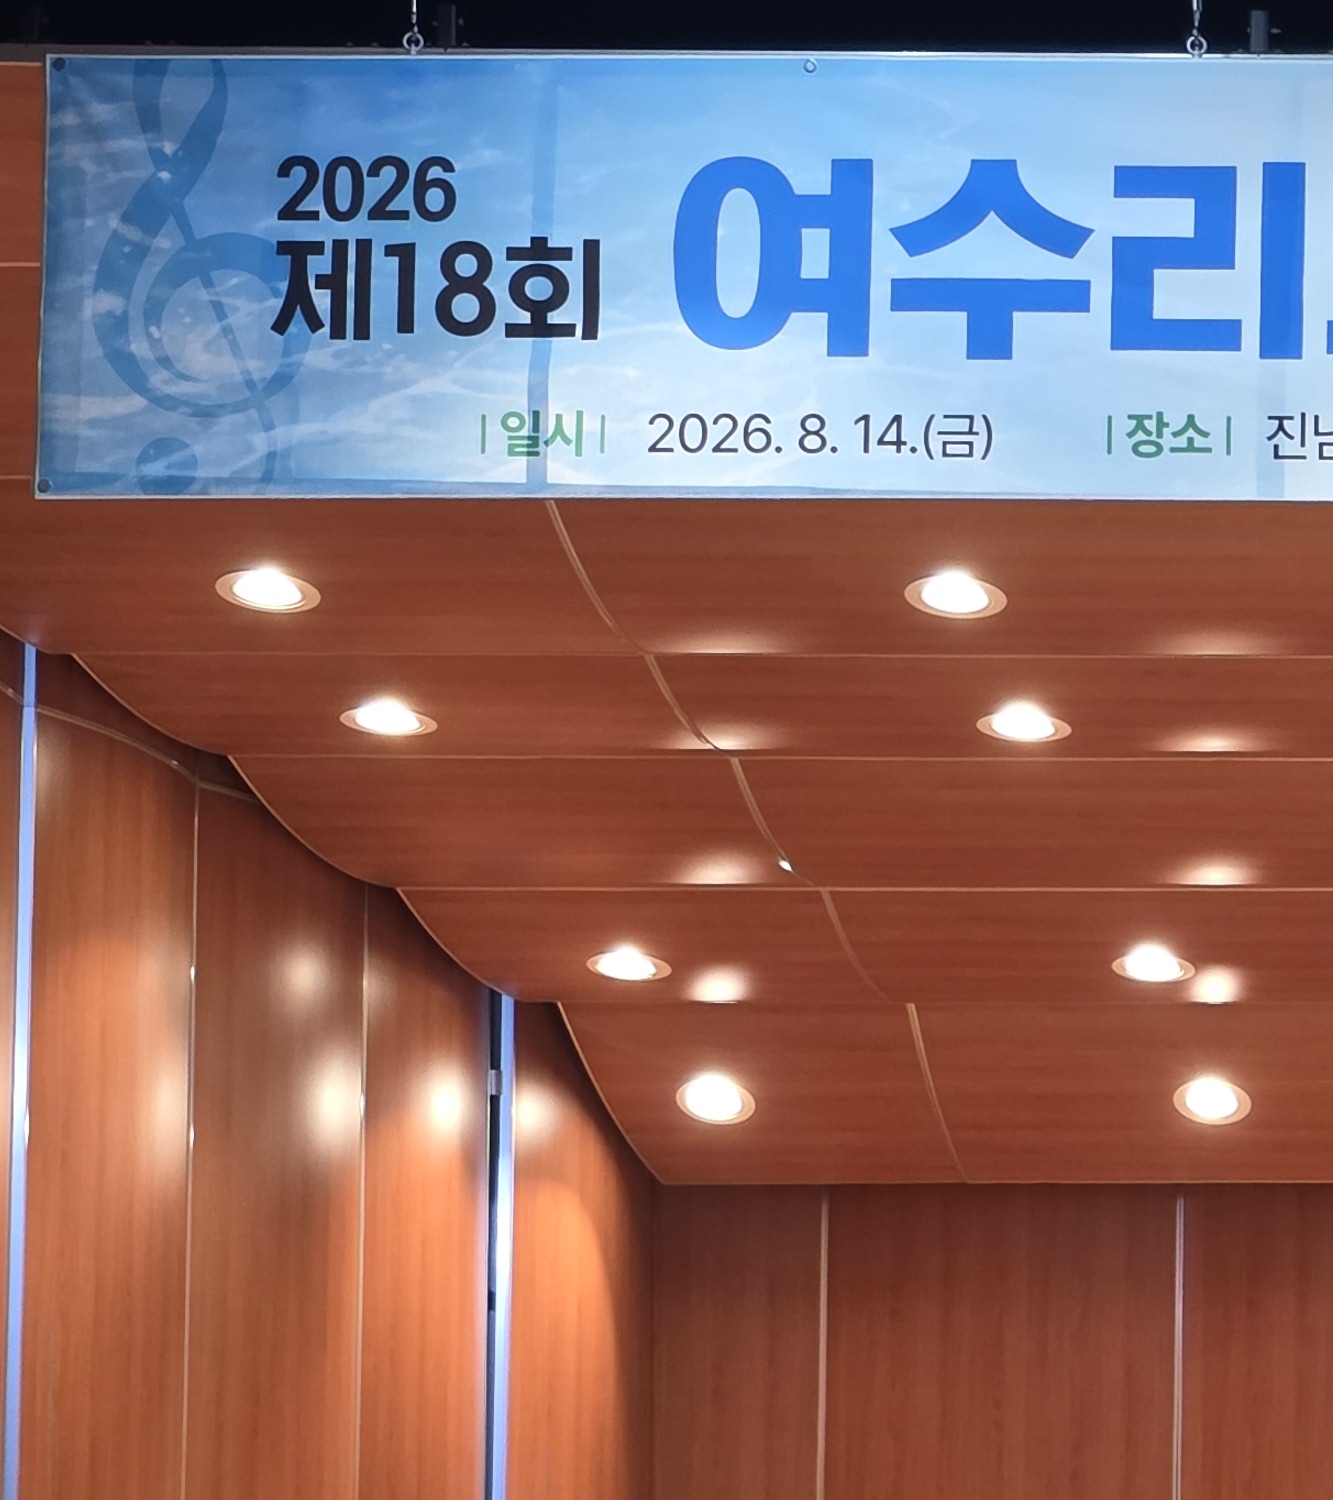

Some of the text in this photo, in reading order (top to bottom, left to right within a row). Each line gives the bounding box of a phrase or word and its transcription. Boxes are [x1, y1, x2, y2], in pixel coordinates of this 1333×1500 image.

[275, 154, 457, 223] 2026
[269, 235, 601, 342] 제18회
[500, 409, 584, 458] 일시
[1125, 410, 1213, 459] 장소
